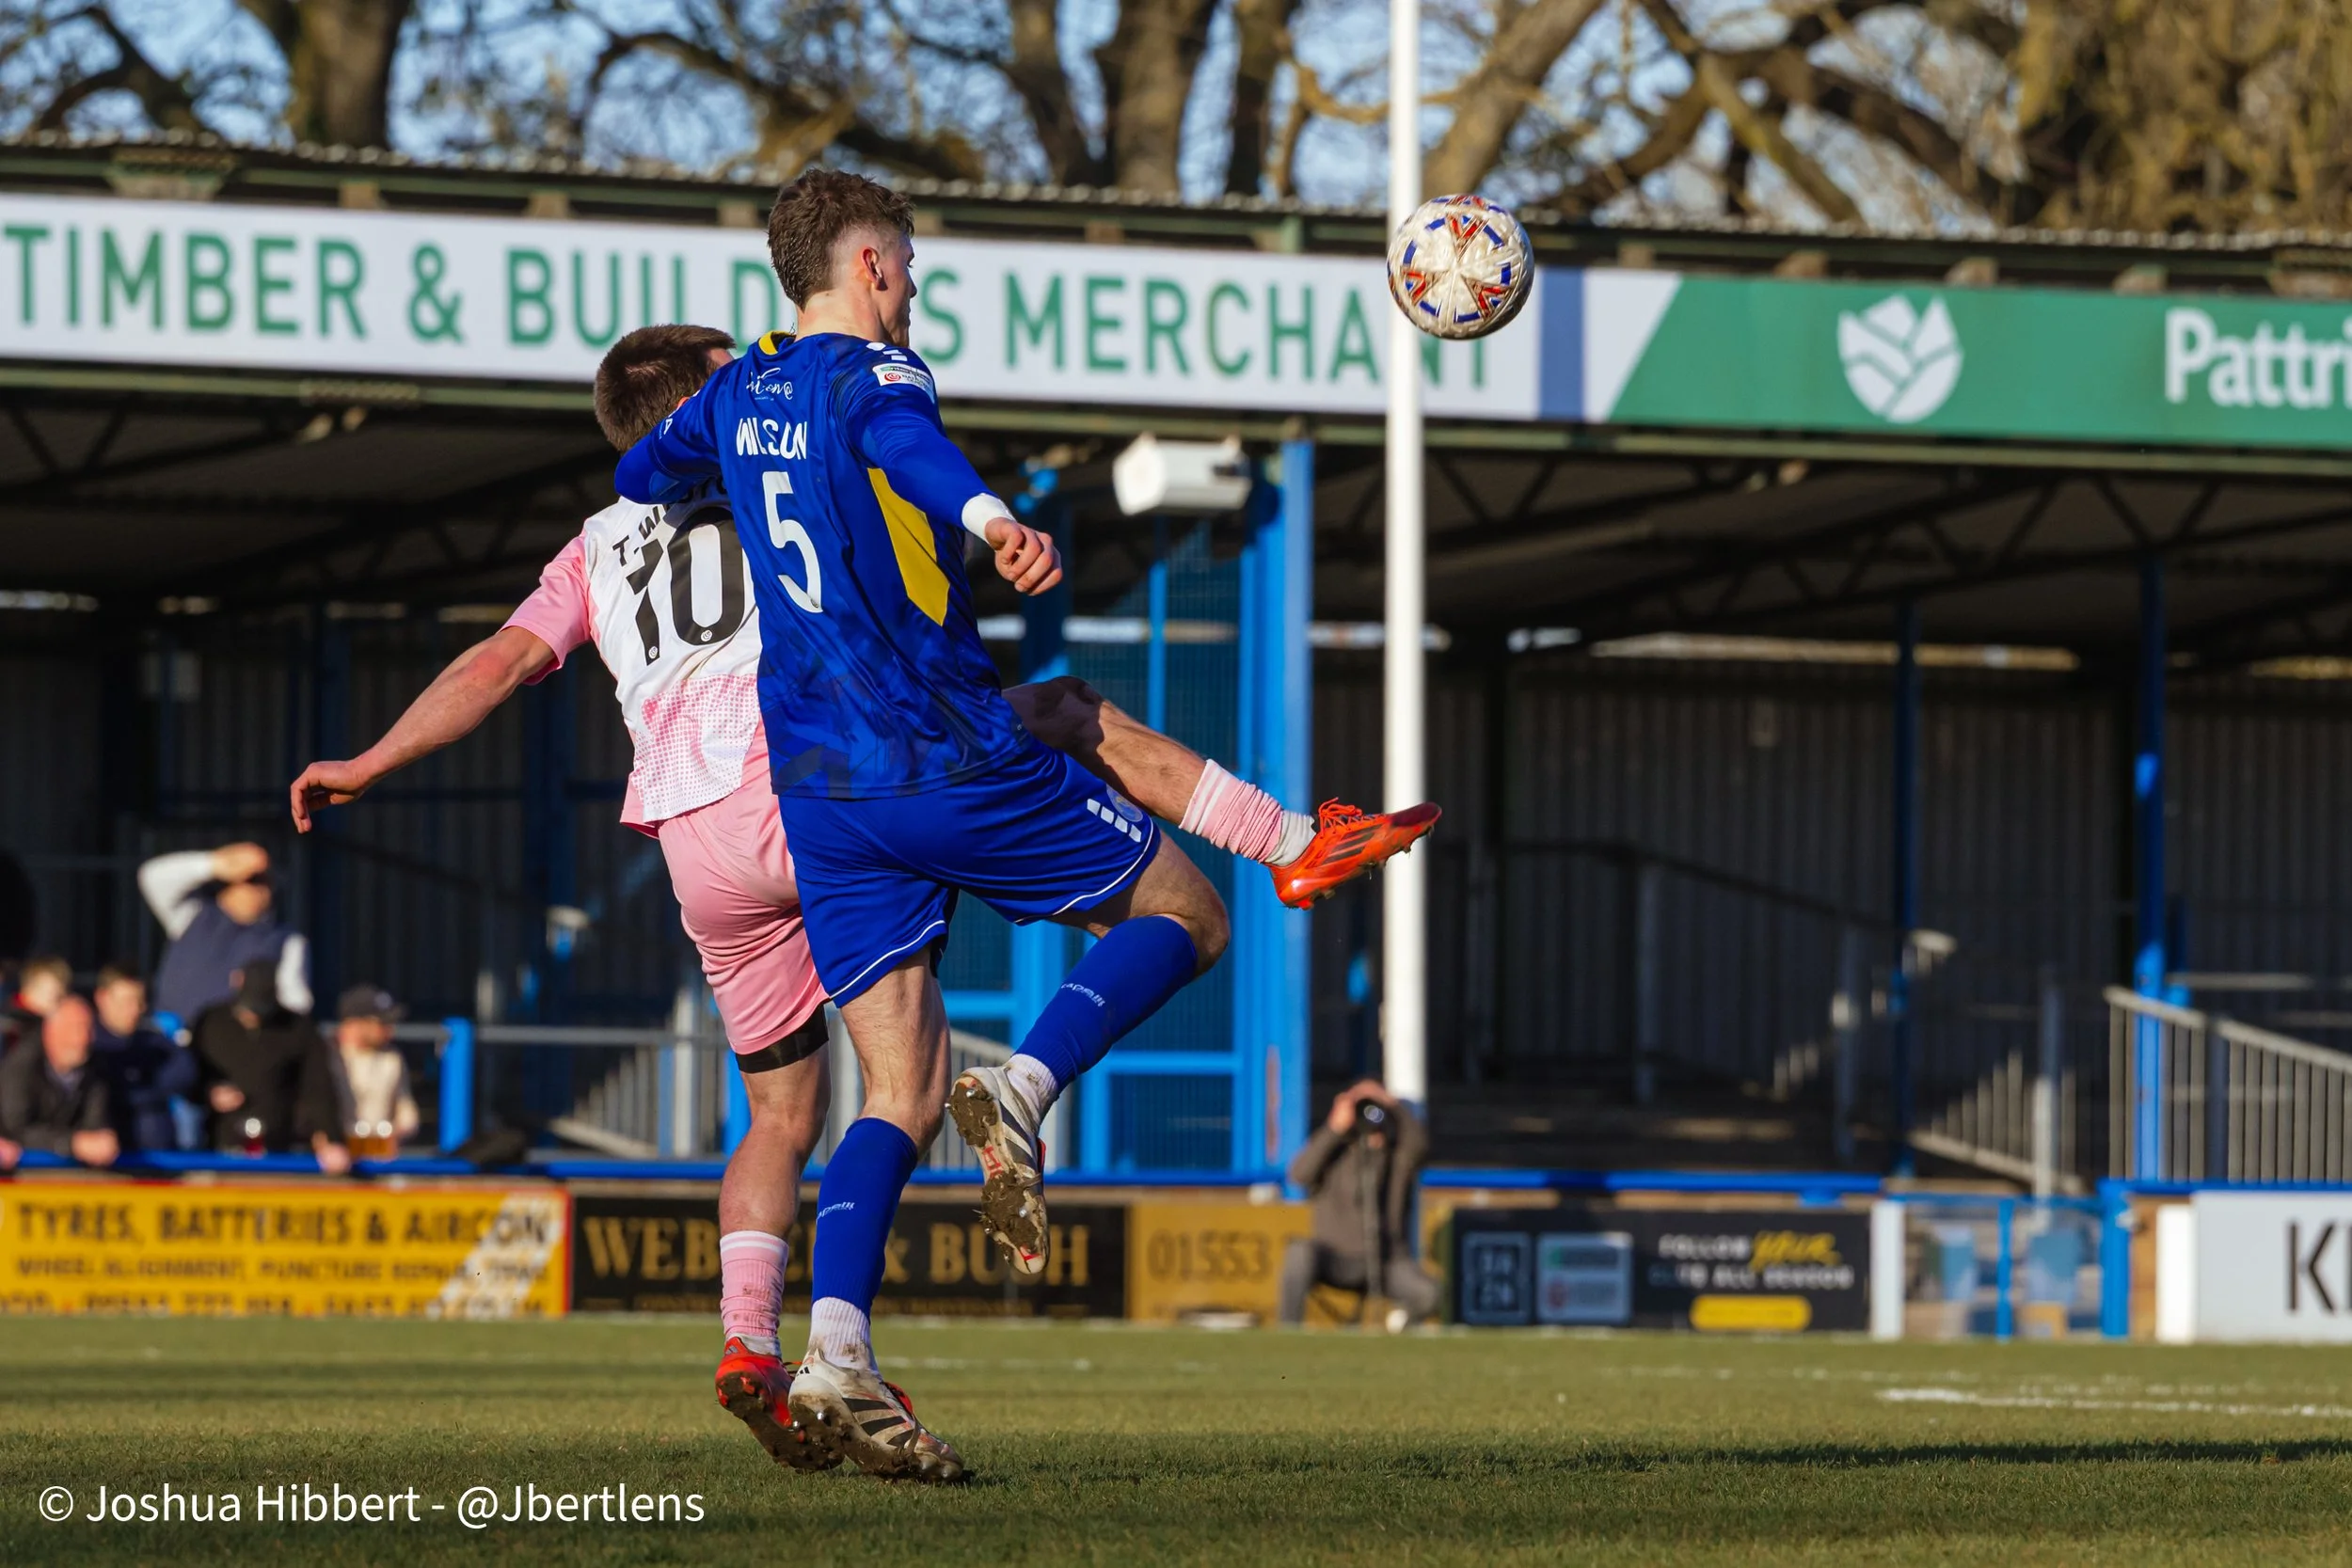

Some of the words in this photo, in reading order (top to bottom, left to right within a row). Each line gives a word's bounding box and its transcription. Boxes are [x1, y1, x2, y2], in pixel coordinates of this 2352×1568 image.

[3, 226, 367, 341] TIMBER
[408, 242, 467, 345] &
[506, 248, 963, 364] BUILDS
[1006, 273, 1488, 388] MERCHA
[736, 417, 808, 461] WILSON
[762, 470, 823, 613] 5
[626, 506, 746, 667] 10
[159, 1204, 352, 1245] BATTERIES
[365, 1208, 388, 1244] &
[928, 1222, 1090, 1288] BUH
[1146, 1228, 1273, 1283] 01553
